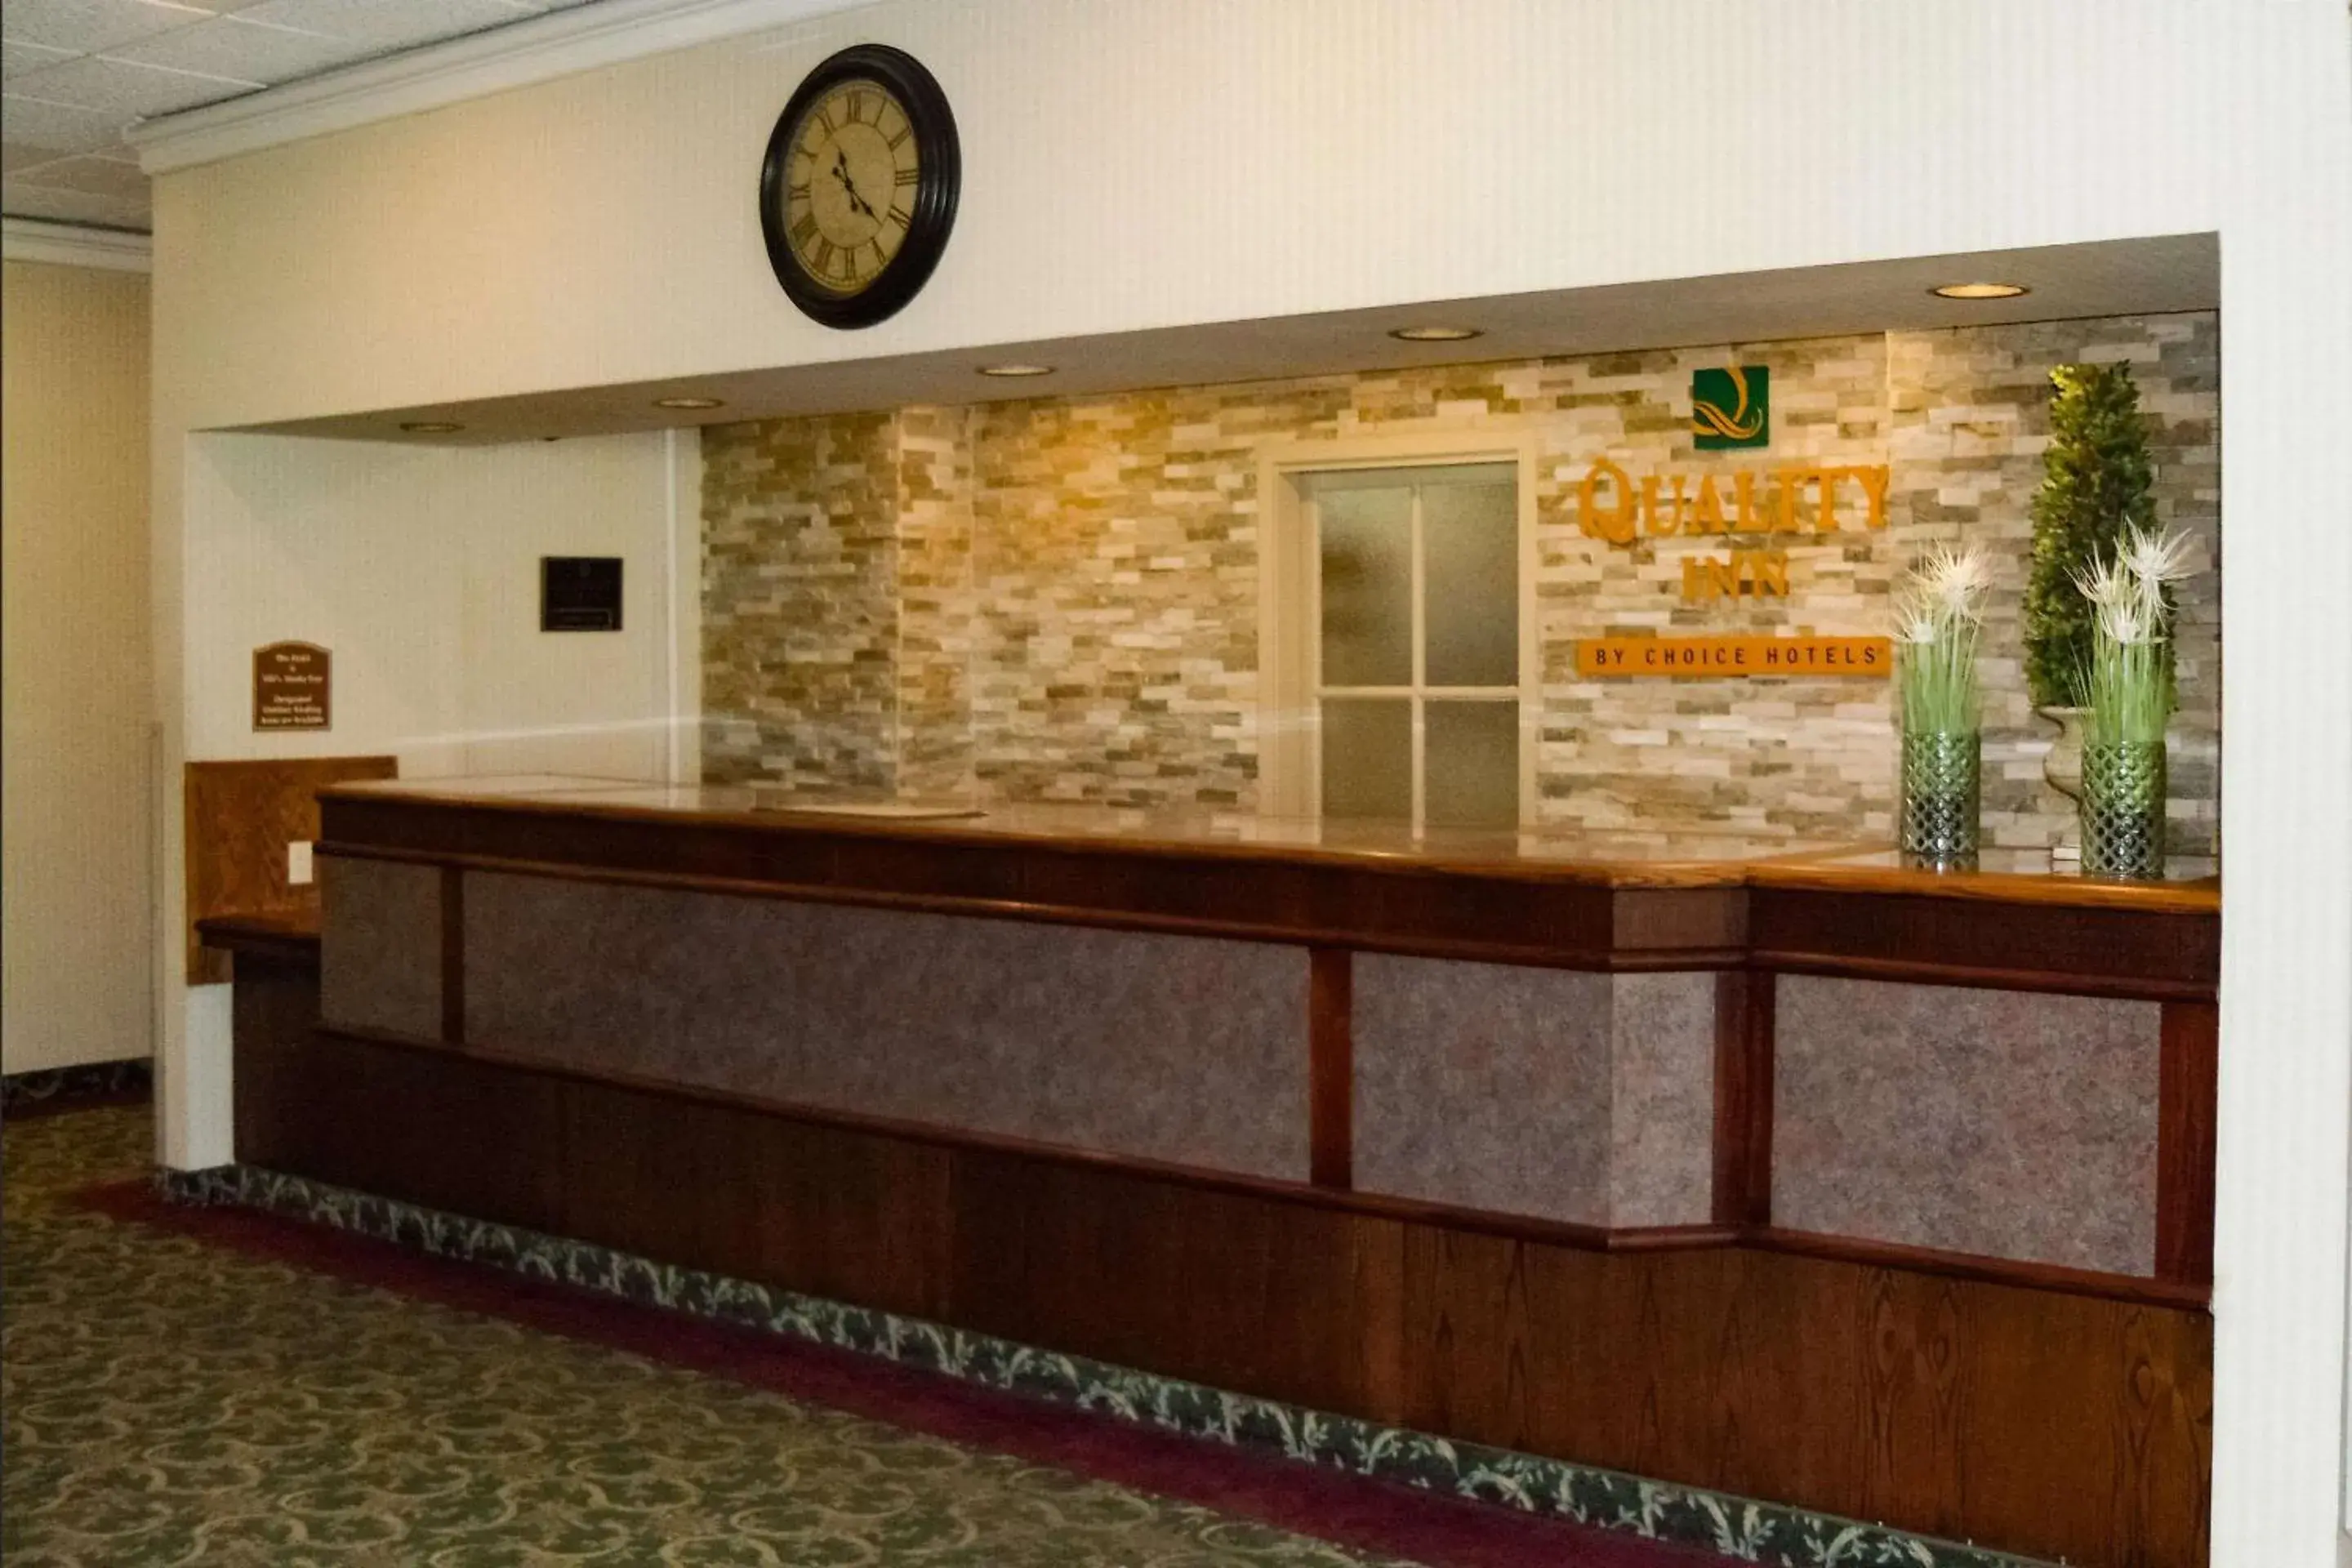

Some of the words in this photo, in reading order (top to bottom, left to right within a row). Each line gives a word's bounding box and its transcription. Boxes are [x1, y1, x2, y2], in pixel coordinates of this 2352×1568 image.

[893, 167, 919, 187] III
[1578, 456, 1890, 546] QUALITY
[1682, 551, 1789, 602] INN
[1595, 649, 1625, 666] BY
[1645, 647, 1746, 666] CHOICE
[1766, 645, 1878, 665] HOTELS
